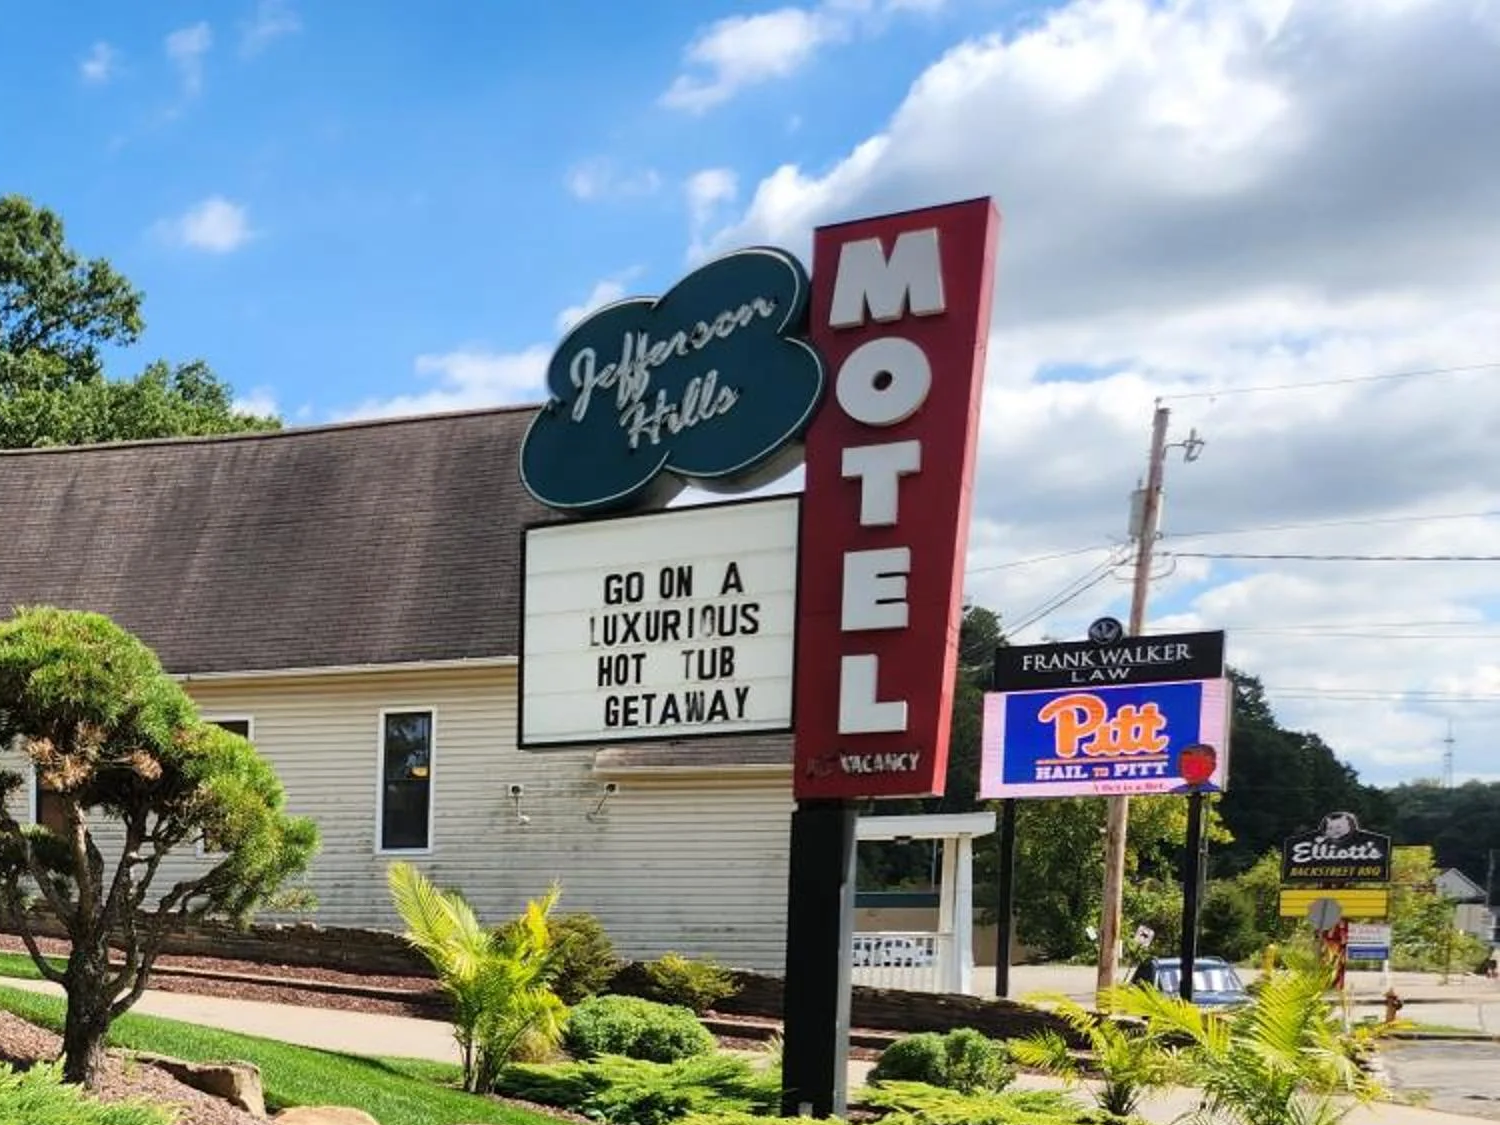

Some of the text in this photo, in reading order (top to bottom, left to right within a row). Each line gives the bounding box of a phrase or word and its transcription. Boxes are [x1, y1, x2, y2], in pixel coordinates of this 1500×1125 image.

[570, 297, 776, 422] Jefferson
[619, 369, 739, 448] Hills
[829, 227, 945, 734] MOTEL
[604, 561, 744, 605] GO ON A
[590, 602, 760, 646] LUXURIOUS
[598, 645, 735, 687] HOT TUB
[1023, 643, 1192, 671] FRANK WALKER
[1071, 668, 1131, 683] LAW
[605, 686, 749, 727] GETAWAY
[1038, 693, 1170, 758] Pitt
[841, 752, 919, 773] VACANCY
[1035, 764, 1088, 781] HAIL
[1113, 762, 1168, 777] PITT
[1292, 840, 1383, 862] Elliott's
